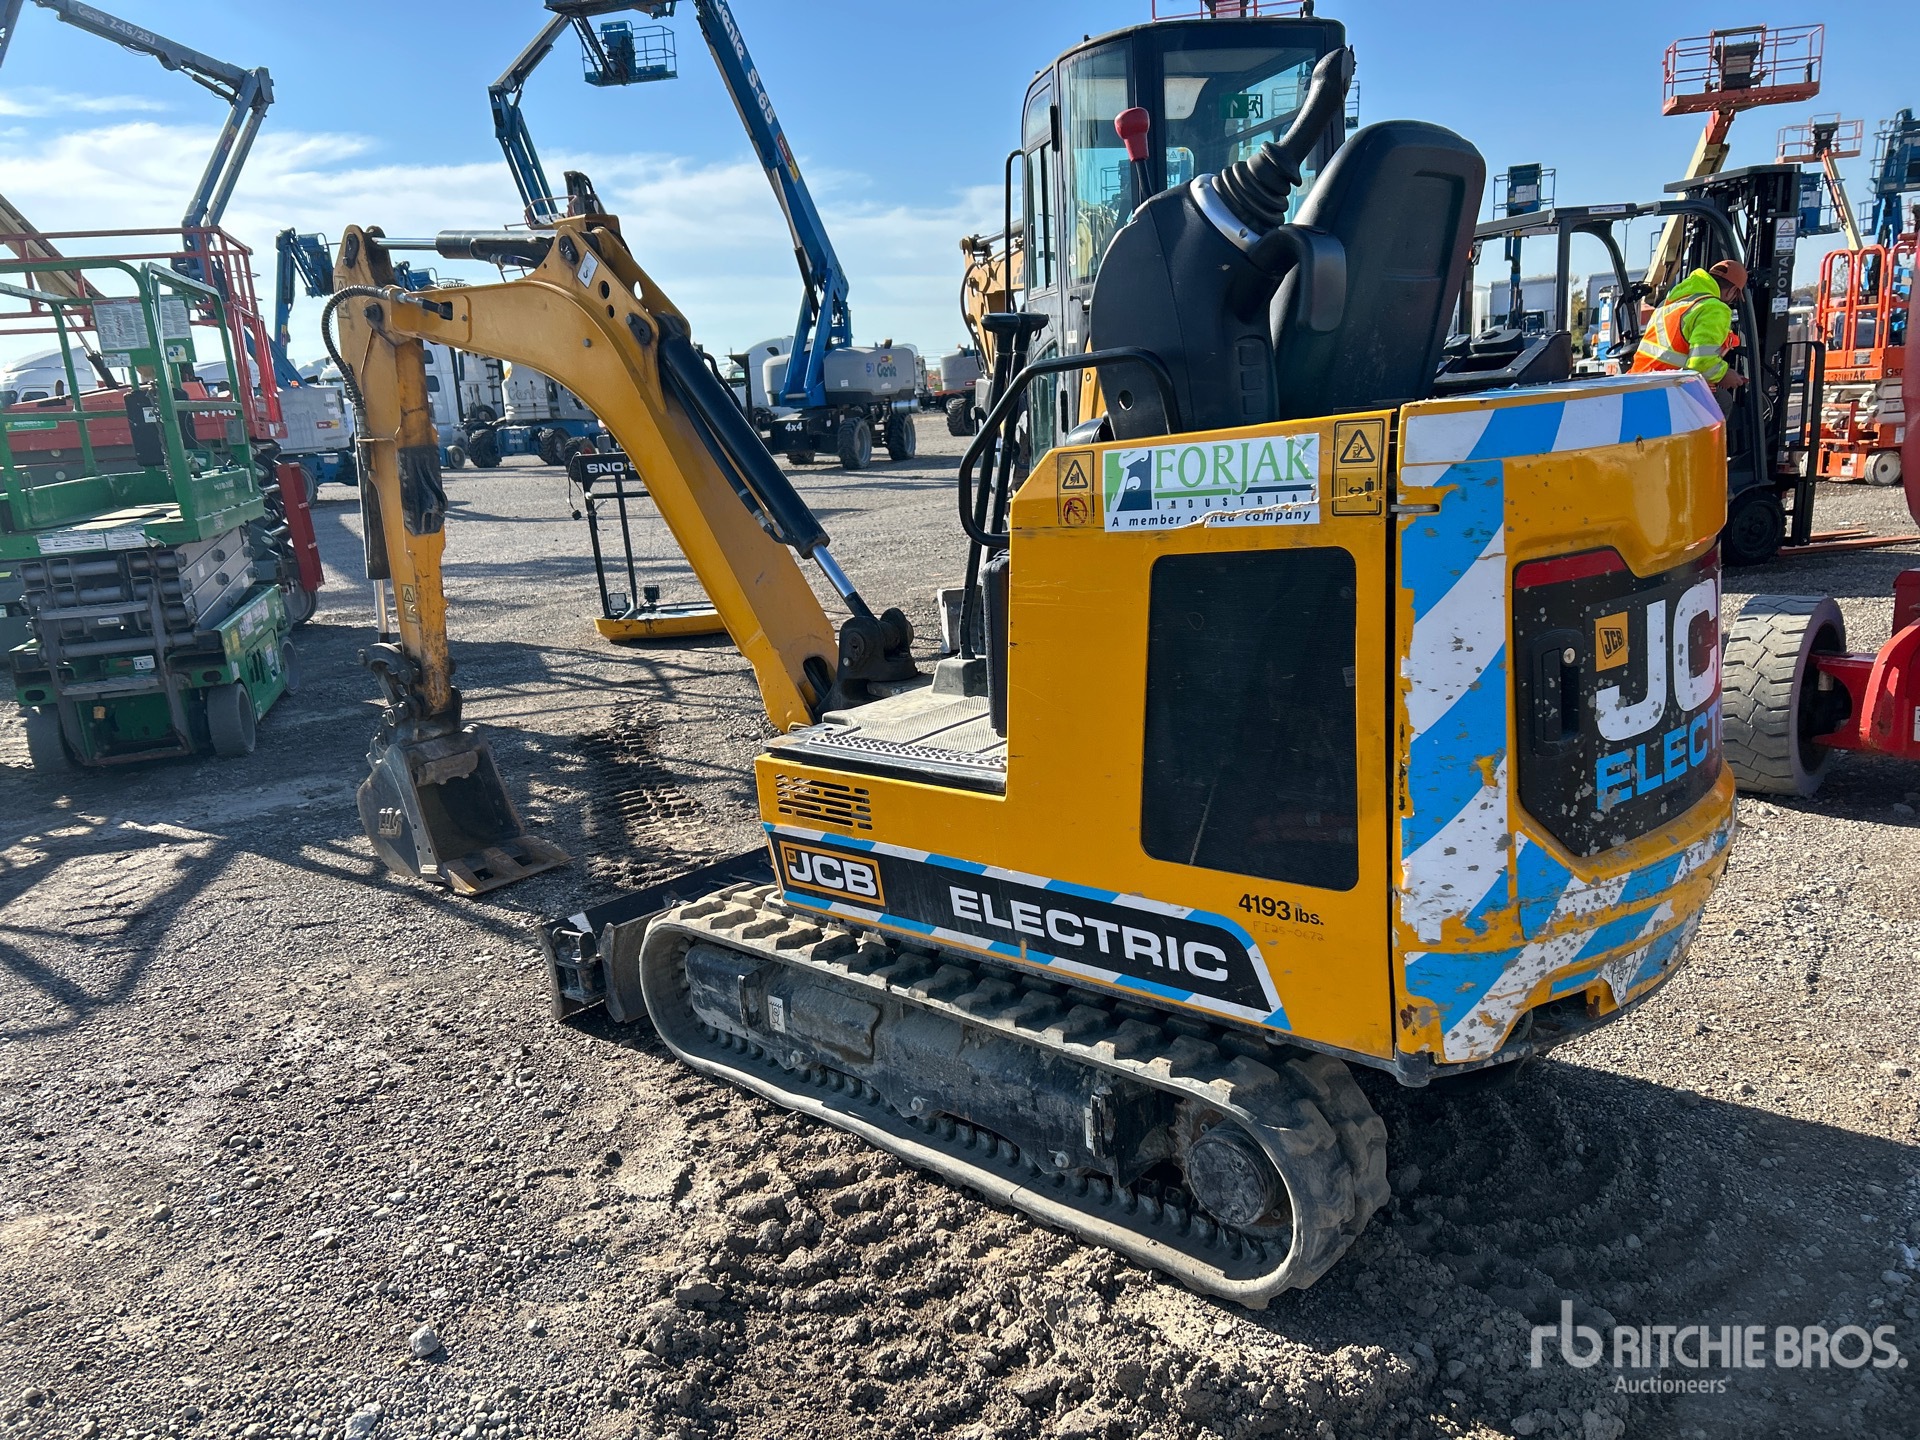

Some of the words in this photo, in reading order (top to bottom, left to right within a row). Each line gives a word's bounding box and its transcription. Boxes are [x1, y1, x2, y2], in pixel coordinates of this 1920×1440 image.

[109, 18, 156, 45] Z-45/25J
[748, 68, 775, 125] S-65
[1774, 256, 1789, 320] TYOTA
[784, 422, 804, 432] 4x4
[586, 461, 625, 474] SNO
[1154, 437, 1315, 496] FORJAK
[1111, 516, 1120, 527] A
[1128, 513, 1182, 526] member
[1191, 513, 1236, 523] oned
[1244, 509, 1311, 523] company
[1595, 571, 1722, 742] JC
[1602, 630, 1625, 656] JCB
[1595, 700, 1722, 811] ELECT
[788, 852, 877, 896] JCB
[1238, 893, 1291, 921] 4193
[1294, 908, 1325, 925] lbs.
[949, 885, 1229, 982] ELECTRIC
